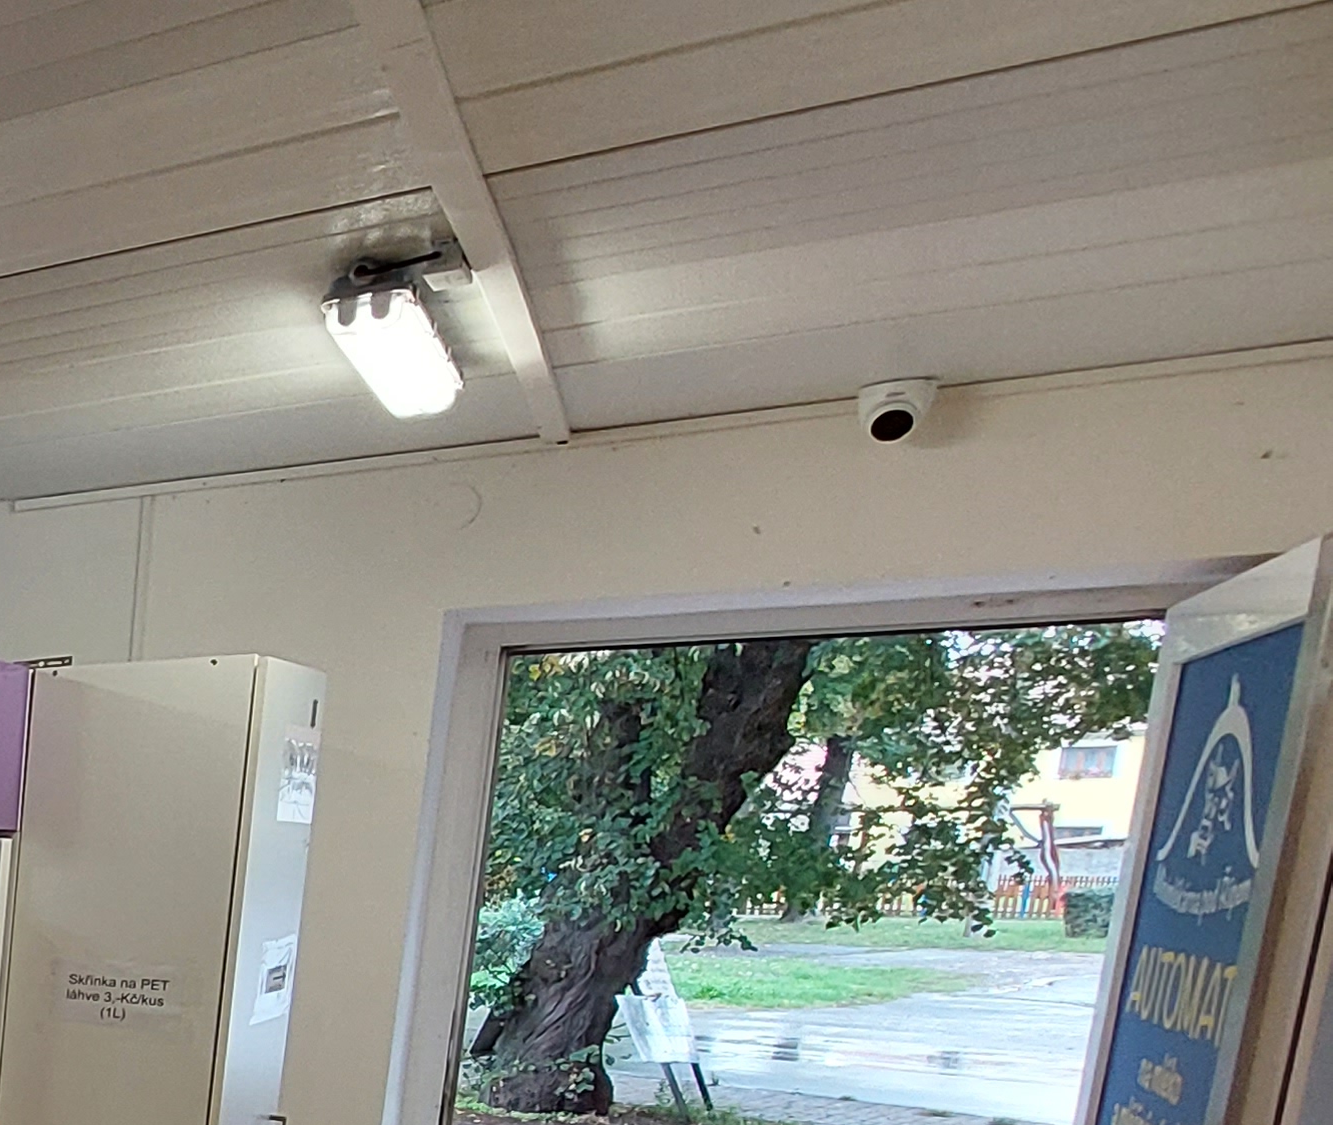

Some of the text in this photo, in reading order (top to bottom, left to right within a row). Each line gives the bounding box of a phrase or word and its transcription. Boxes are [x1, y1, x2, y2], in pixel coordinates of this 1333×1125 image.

[120, 979, 137, 989] na
[140, 978, 171, 991] PET
[66, 988, 100, 1002] láhve
[1125, 943, 1238, 1048] AUTOMAT
[100, 1006, 126, 1021] (1L)
